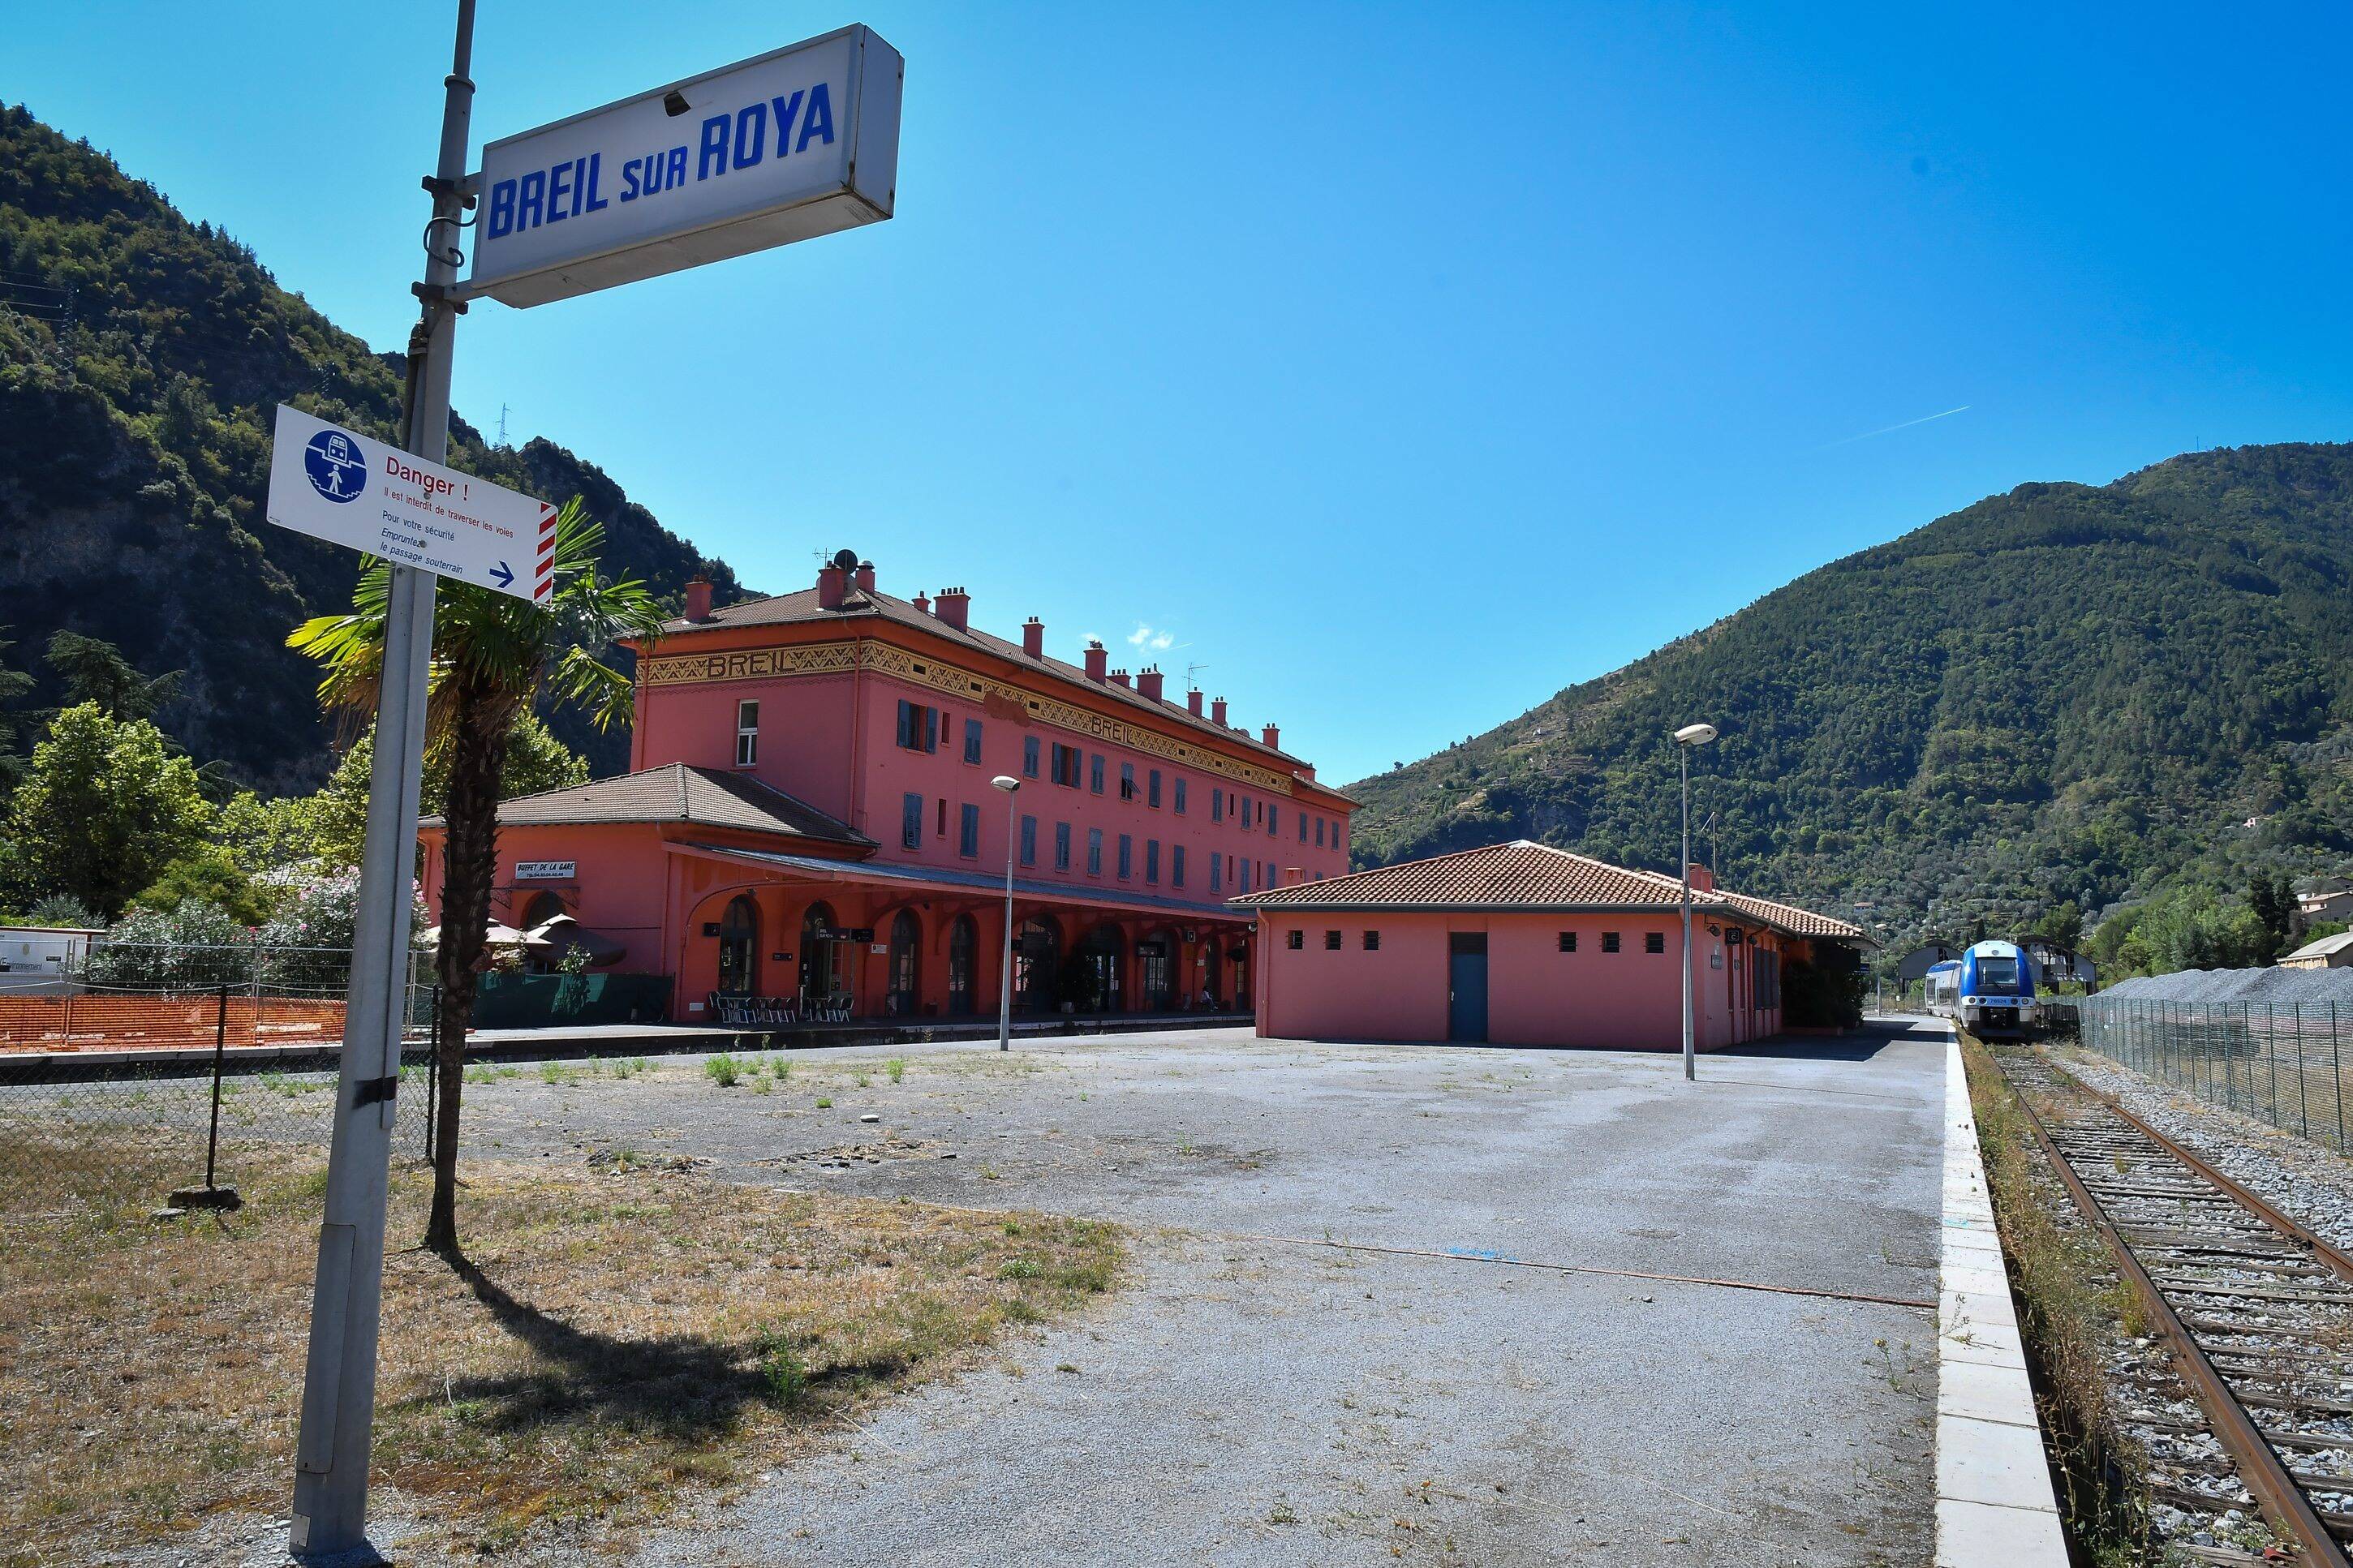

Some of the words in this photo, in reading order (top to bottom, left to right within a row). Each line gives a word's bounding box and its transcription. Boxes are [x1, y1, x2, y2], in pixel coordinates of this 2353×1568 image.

[488, 153, 609, 240] BREIL
[620, 145, 688, 203] SUR
[697, 83, 835, 181] ROYA
[386, 456, 454, 496] Danger
[463, 484, 468, 500] !
[382, 510, 399, 523] Pour
[403, 519, 422, 531] votre
[425, 526, 454, 541] sécurité
[384, 487, 389, 496] Il
[392, 492, 403, 501] est
[406, 495, 432, 511] interdit
[435, 505, 445, 515] de
[448, 510, 480, 527] traverser
[482, 520, 493, 531] les
[496, 526, 514, 538] voies
[381, 527, 421, 548] Empruntez
[380, 541, 388, 551] le
[389, 547, 422, 562] passage
[425, 557, 462, 574] souterrain
[708, 650, 795, 678] BREIL
[1092, 716, 1135, 745] BREIL
